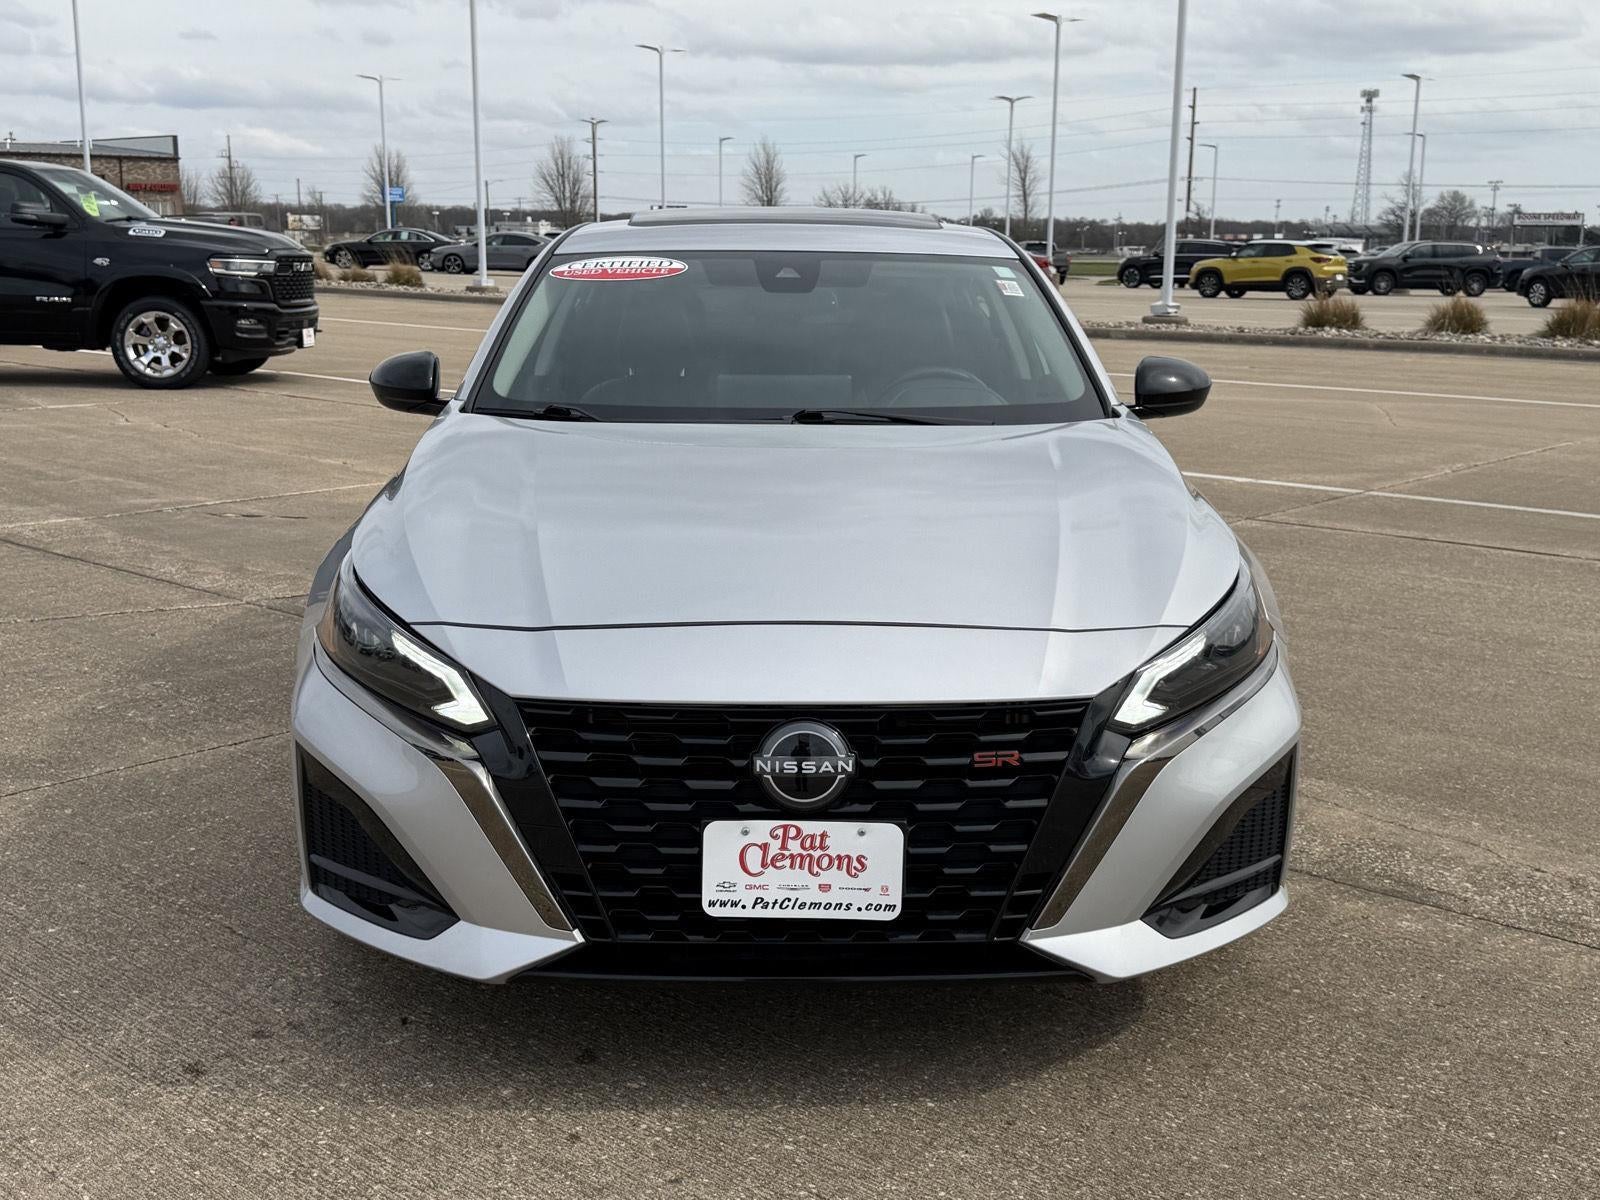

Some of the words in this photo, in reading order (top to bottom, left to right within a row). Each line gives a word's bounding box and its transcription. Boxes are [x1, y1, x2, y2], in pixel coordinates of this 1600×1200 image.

[563, 268, 601, 276] USED
[568, 260, 674, 270] CERTIFIED
[756, 759, 853, 774] NISSAN
[973, 750, 1020, 768] SR
[769, 823, 831, 852] Pat
[738, 842, 869, 879] Clemons
